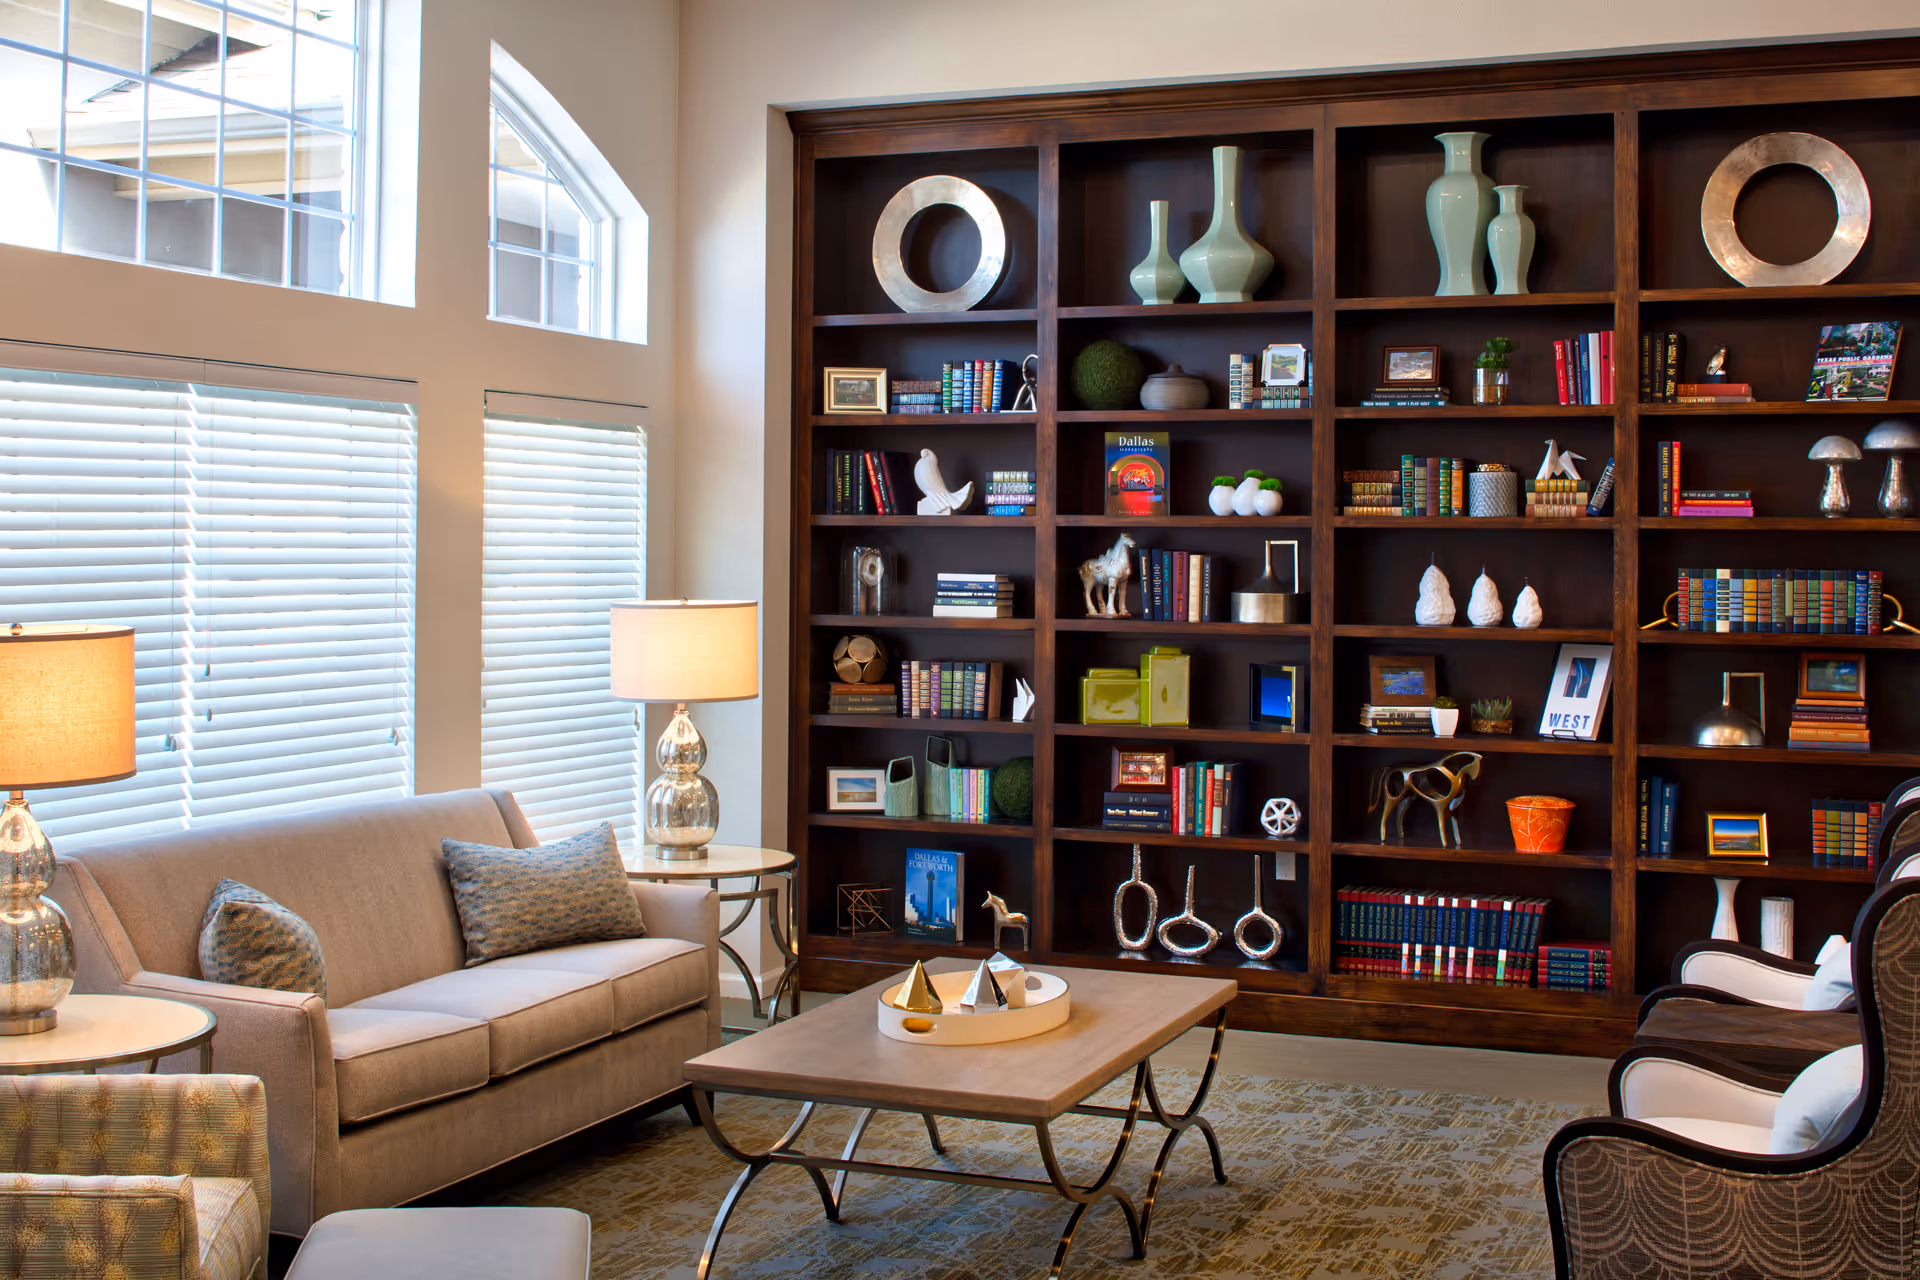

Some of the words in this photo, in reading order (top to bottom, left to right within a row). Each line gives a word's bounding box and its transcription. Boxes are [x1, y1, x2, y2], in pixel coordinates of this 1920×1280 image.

[1119, 436, 1154, 446] Dallas
[1548, 712, 1591, 729] WEST
[914, 852, 940, 863] DALLAS
[909, 860, 928, 869] FORT
[928, 862, 953, 872] WORTH
